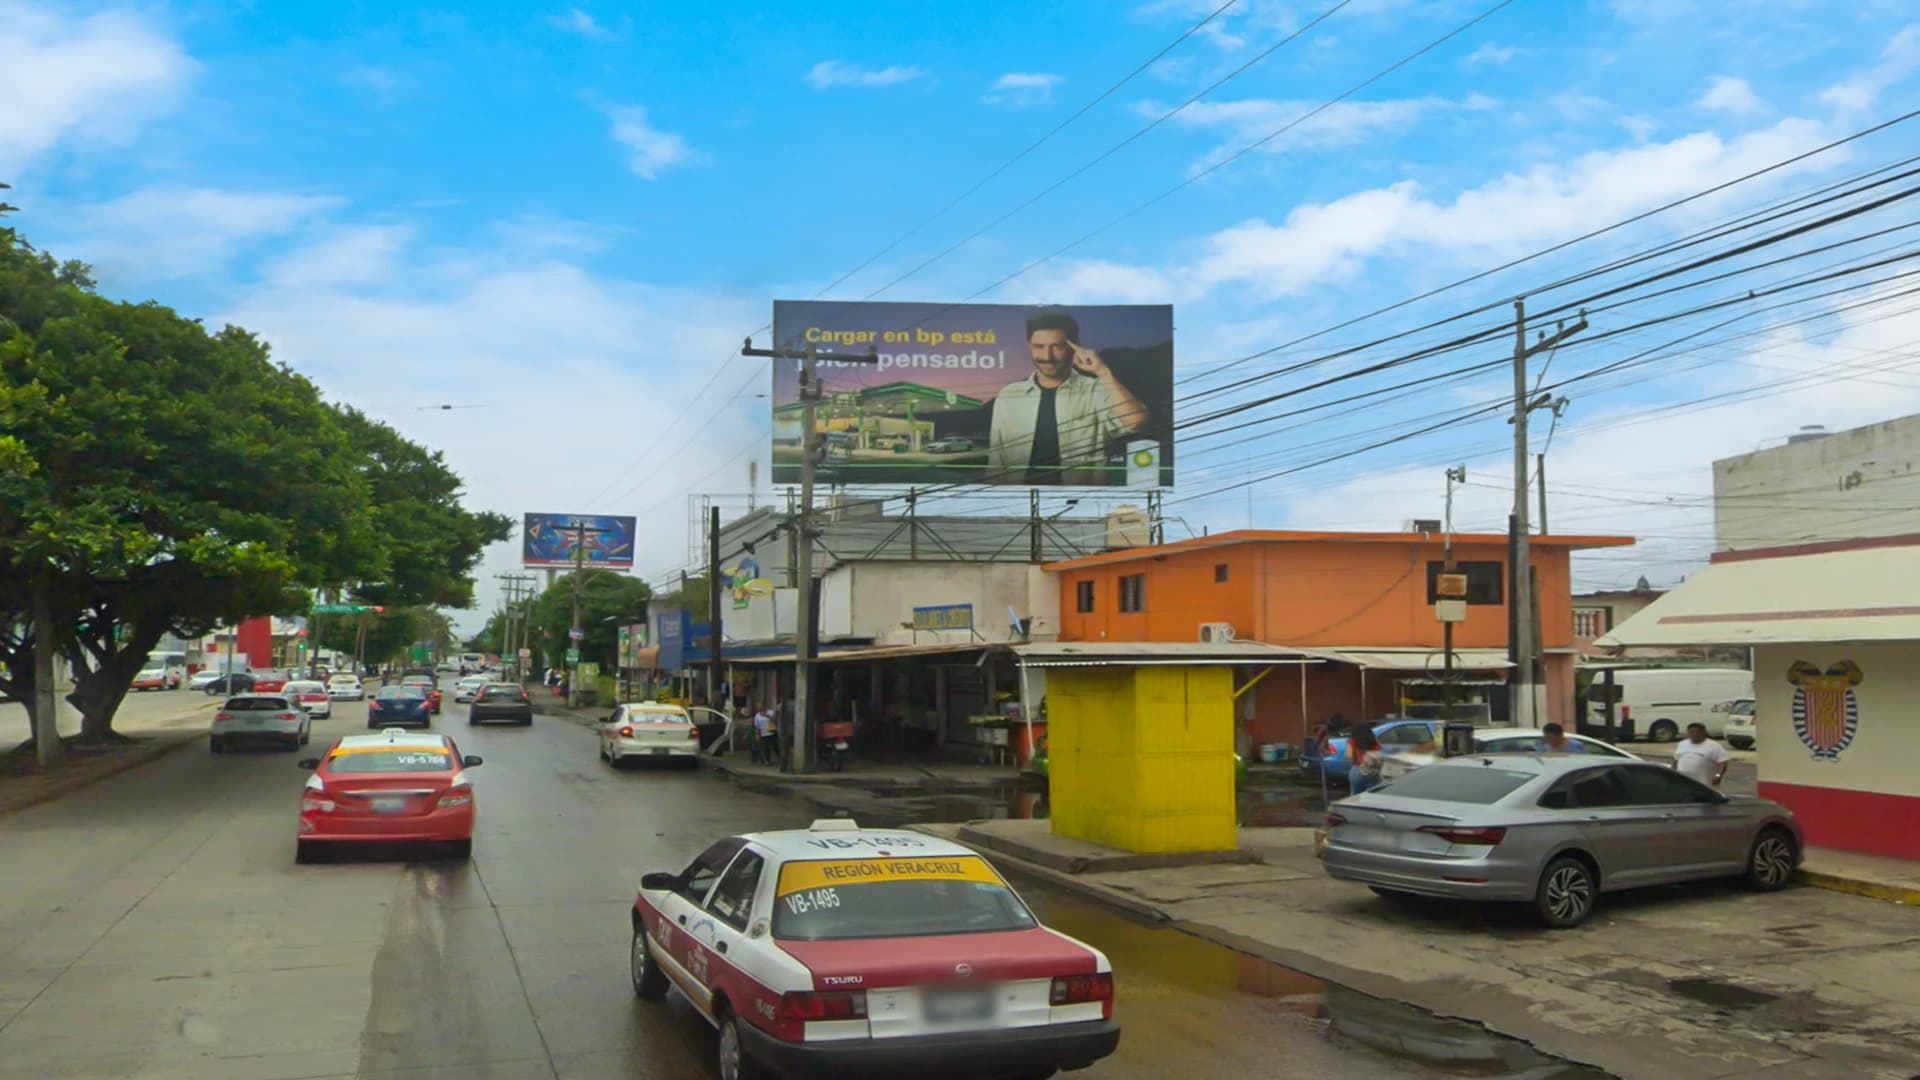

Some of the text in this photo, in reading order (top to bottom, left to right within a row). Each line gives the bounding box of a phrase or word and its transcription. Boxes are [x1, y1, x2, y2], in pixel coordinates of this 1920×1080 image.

[805, 327, 996, 346] Cargar en bp está
[877, 350, 1005, 372] pensado!
[807, 836, 925, 850] VB-1495
[823, 861, 965, 880] REGIÓN VERACRUZ
[785, 887, 840, 915] VB-1495
[823, 975, 863, 985] TSURU
